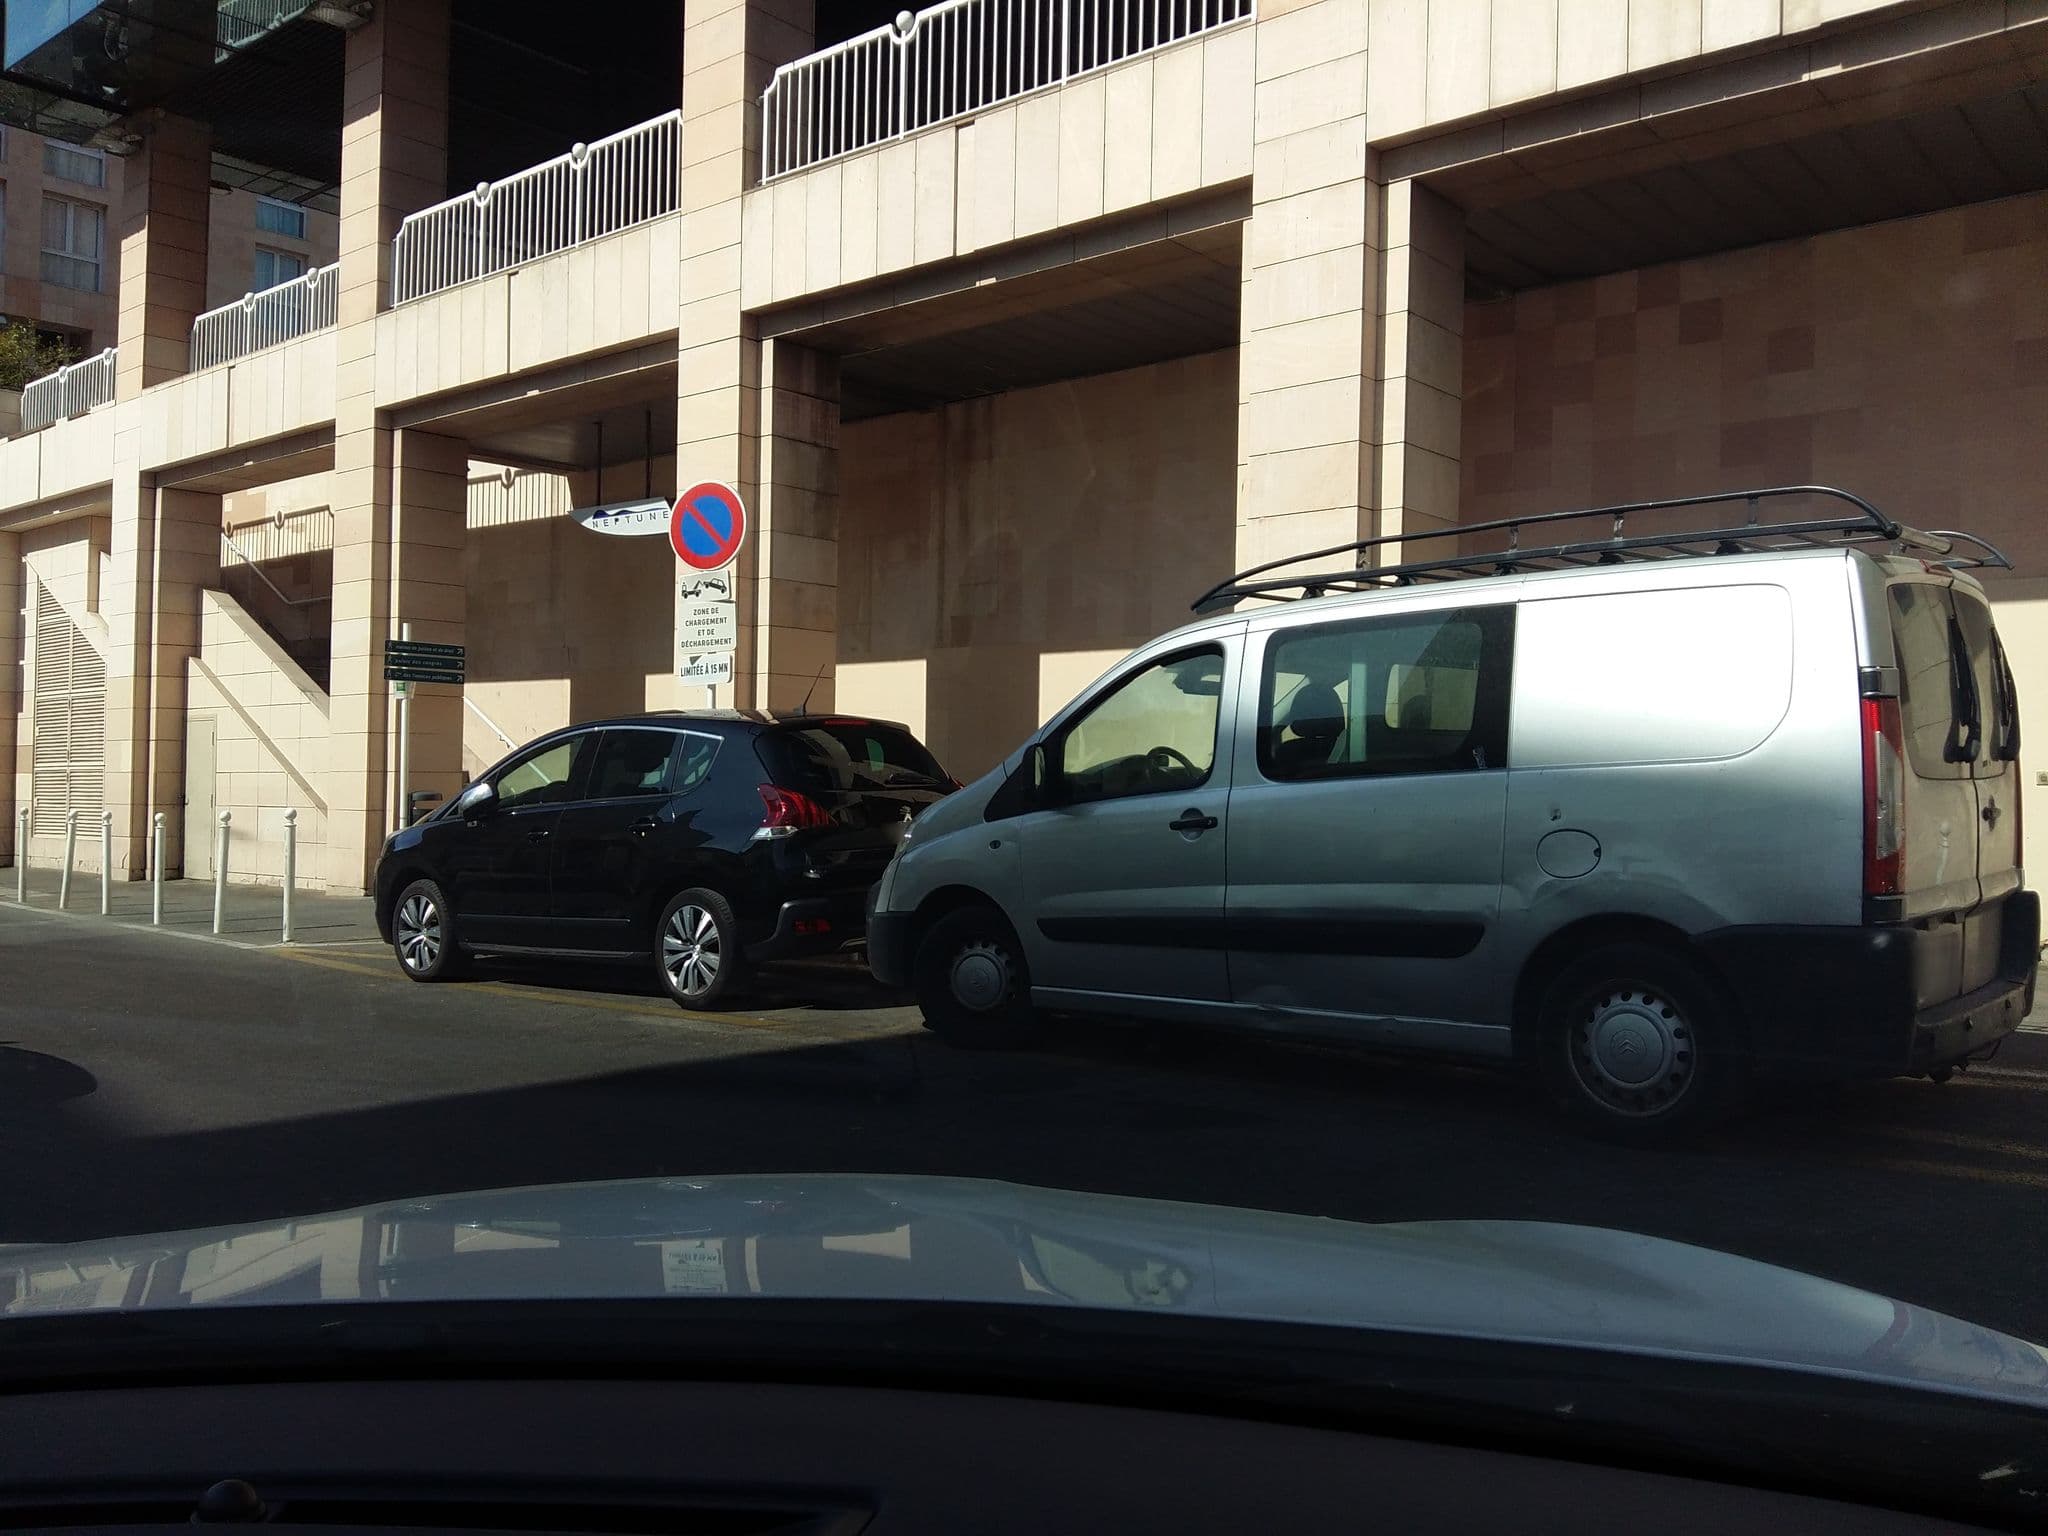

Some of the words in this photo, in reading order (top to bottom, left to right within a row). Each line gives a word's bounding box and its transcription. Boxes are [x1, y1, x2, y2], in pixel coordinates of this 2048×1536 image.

[592, 510, 669, 528] NEPTUNE
[693, 607, 709, 616] ZONE
[685, 617, 727, 627] CHARGEMENT
[706, 628, 715, 636] DE
[681, 638, 732, 648] DÉCHARGEMENT
[681, 663, 703, 677] LIMITÉE
[705, 663, 709, 675] À
[710, 664, 717, 674] 15
[718, 663, 728, 673] MN
